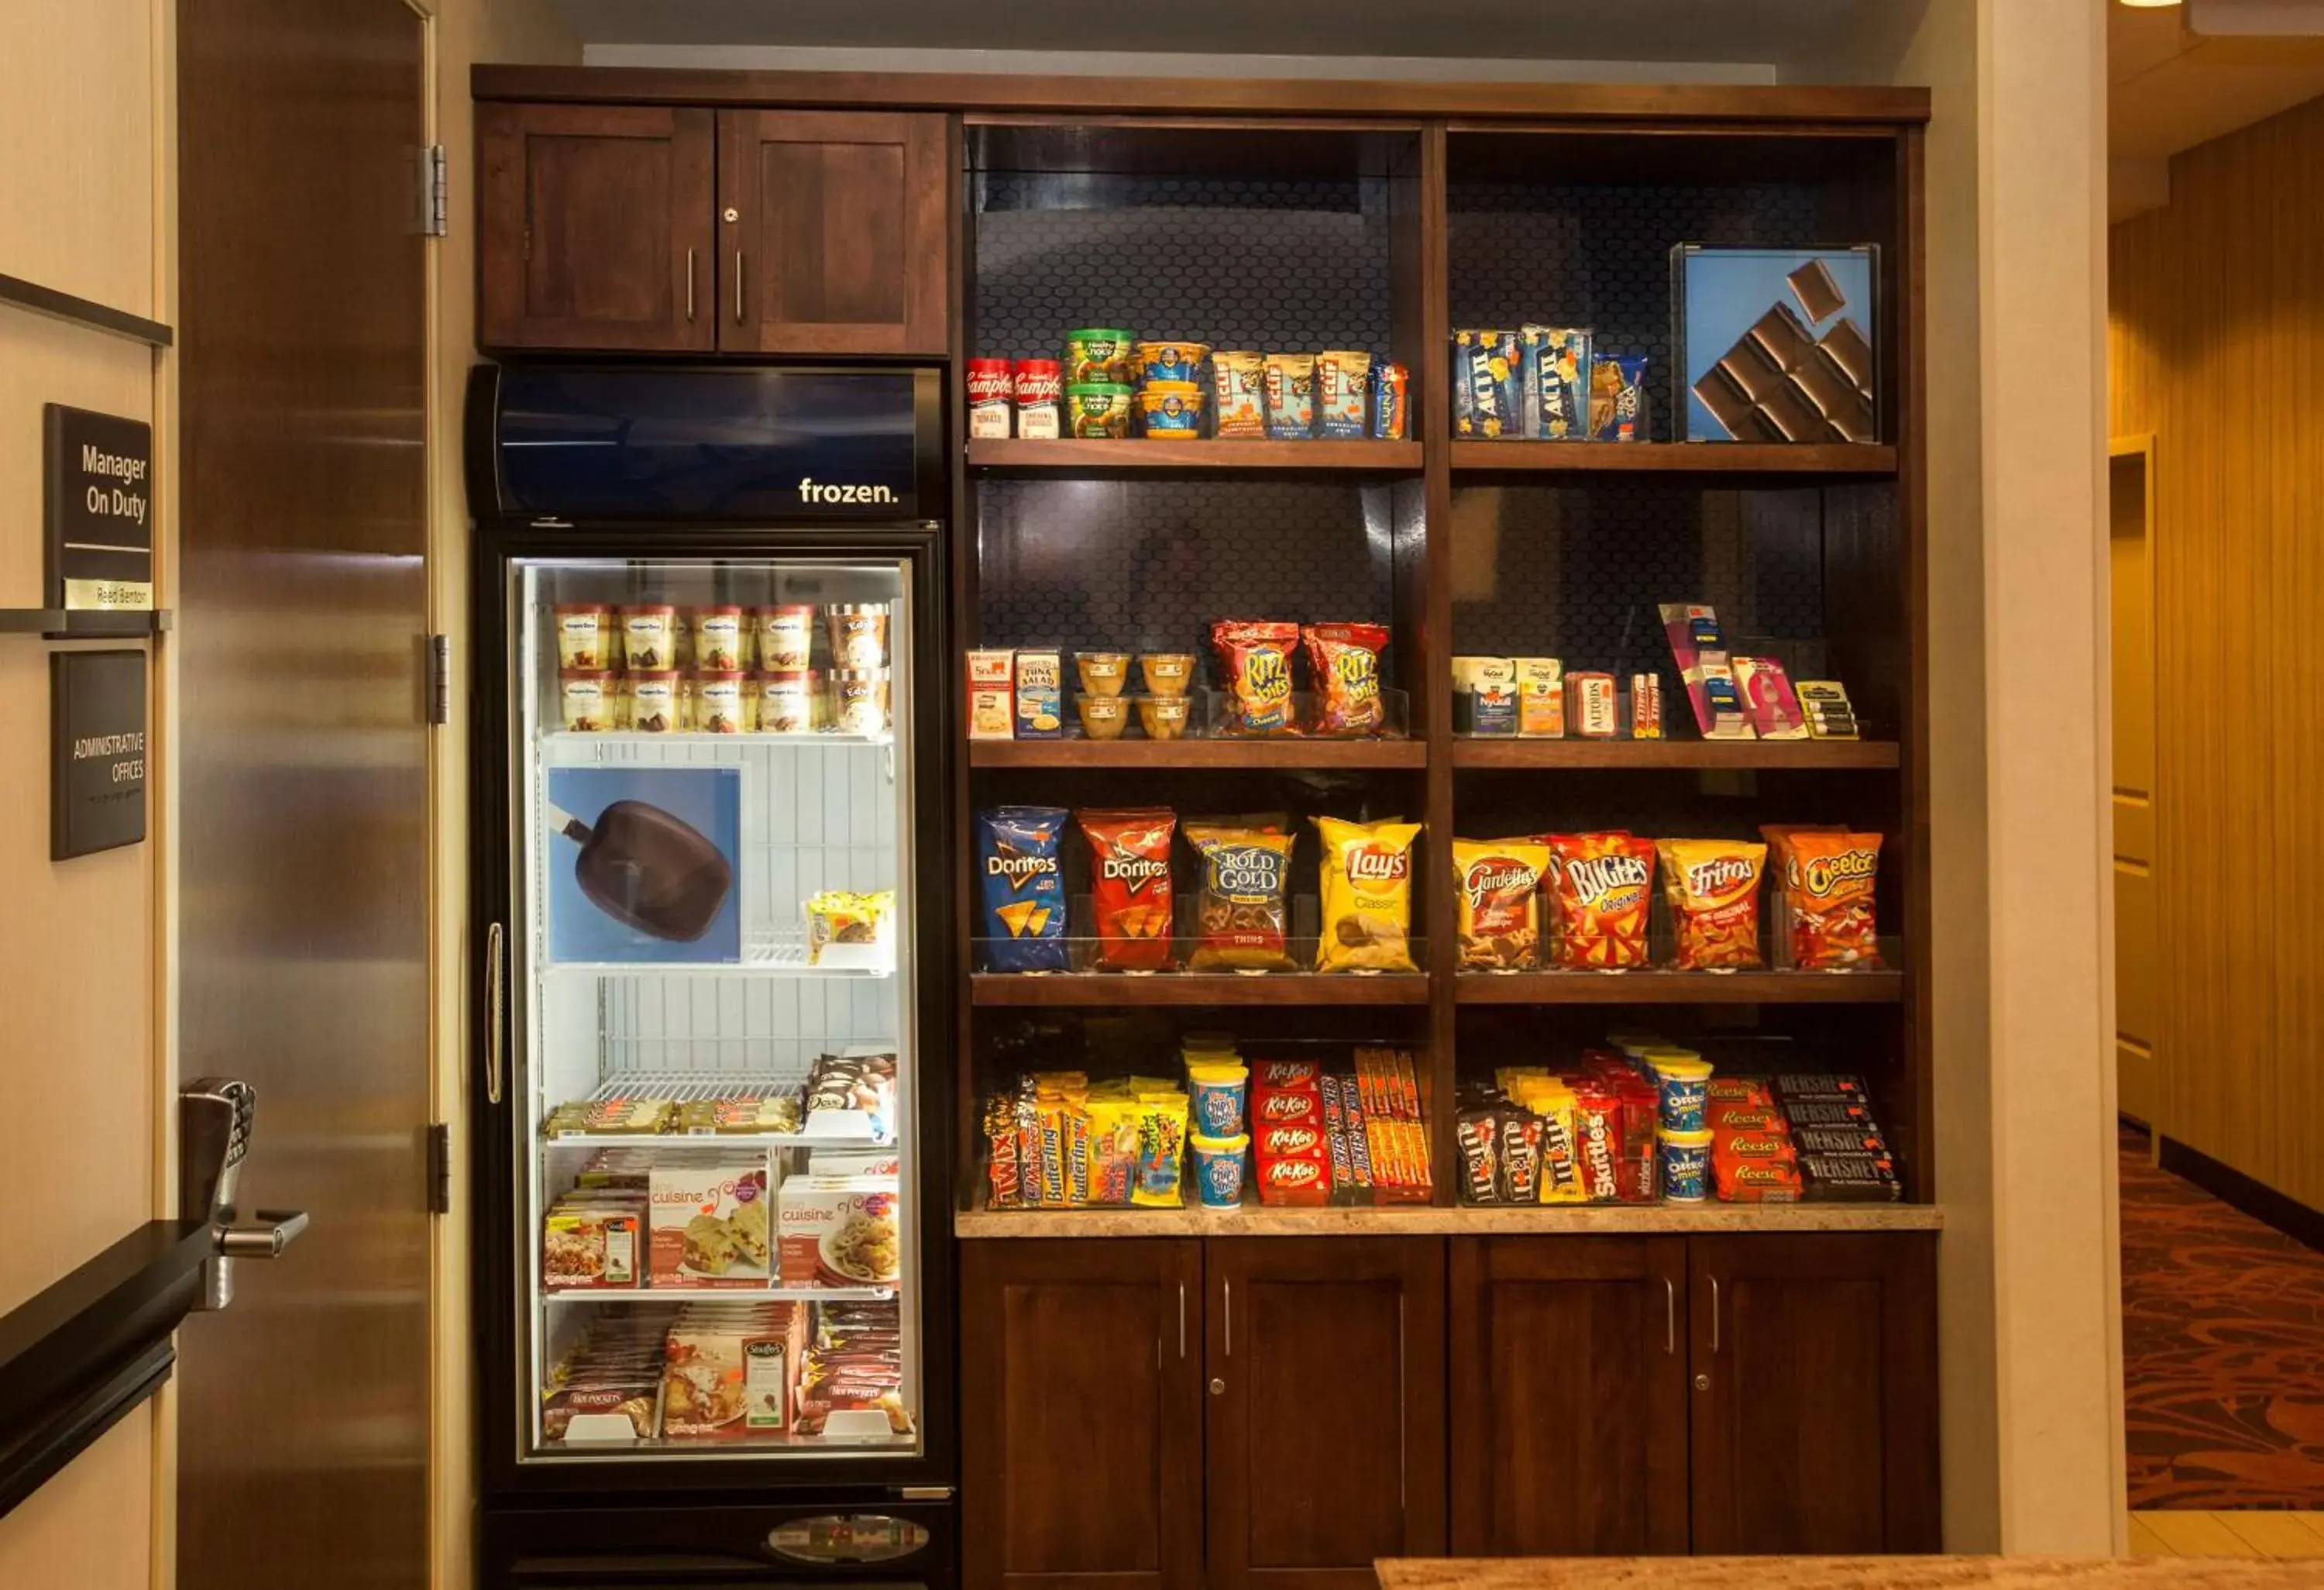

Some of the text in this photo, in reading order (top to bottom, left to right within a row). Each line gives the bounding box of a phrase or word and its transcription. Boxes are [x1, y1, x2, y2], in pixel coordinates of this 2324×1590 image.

[1217, 362, 1231, 396] CLIF
[1269, 366, 1283, 401] CLIF
[1325, 361, 1339, 395] CLIF
[1471, 350, 1498, 417] ACT II
[1540, 353, 1564, 417] ACT II
[1380, 382, 1394, 428] LUNA
[83, 444, 146, 485] Manager
[799, 477, 899, 503] frozen.
[87, 486, 146, 525] On Duty
[1026, 667, 1051, 677] TUNA
[1243, 654, 1286, 682] RITZ
[1336, 653, 1377, 680] RITZ
[1022, 676, 1055, 686] SALAD
[1590, 682, 1602, 729] ALTOIDS
[74, 731, 143, 760] ADMINISTRATIVE
[112, 759, 143, 783] OFFICES
[988, 856, 1057, 875] Doritos
[1104, 859, 1168, 878] Doritos
[1226, 853, 1274, 871] ROLD
[1349, 848, 1408, 879] Lay's
[1219, 869, 1277, 890] GOLD
[1464, 863, 1538, 909] Gardetto's
[1566, 854, 1648, 906] BUGLES
[1689, 859, 1753, 896] Fritos
[1354, 897, 1397, 910] Classic
[1668, 1095, 1704, 1107] OREO
[1590, 1114, 1616, 1196] Skittles
[1730, 1137, 1780, 1151] Reese's
[993, 1134, 1018, 1196] TWIX
[1668, 1162, 1703, 1173] OREO
[651, 1192, 704, 1204] cuisine
[782, 1209, 835, 1222] cuisine
